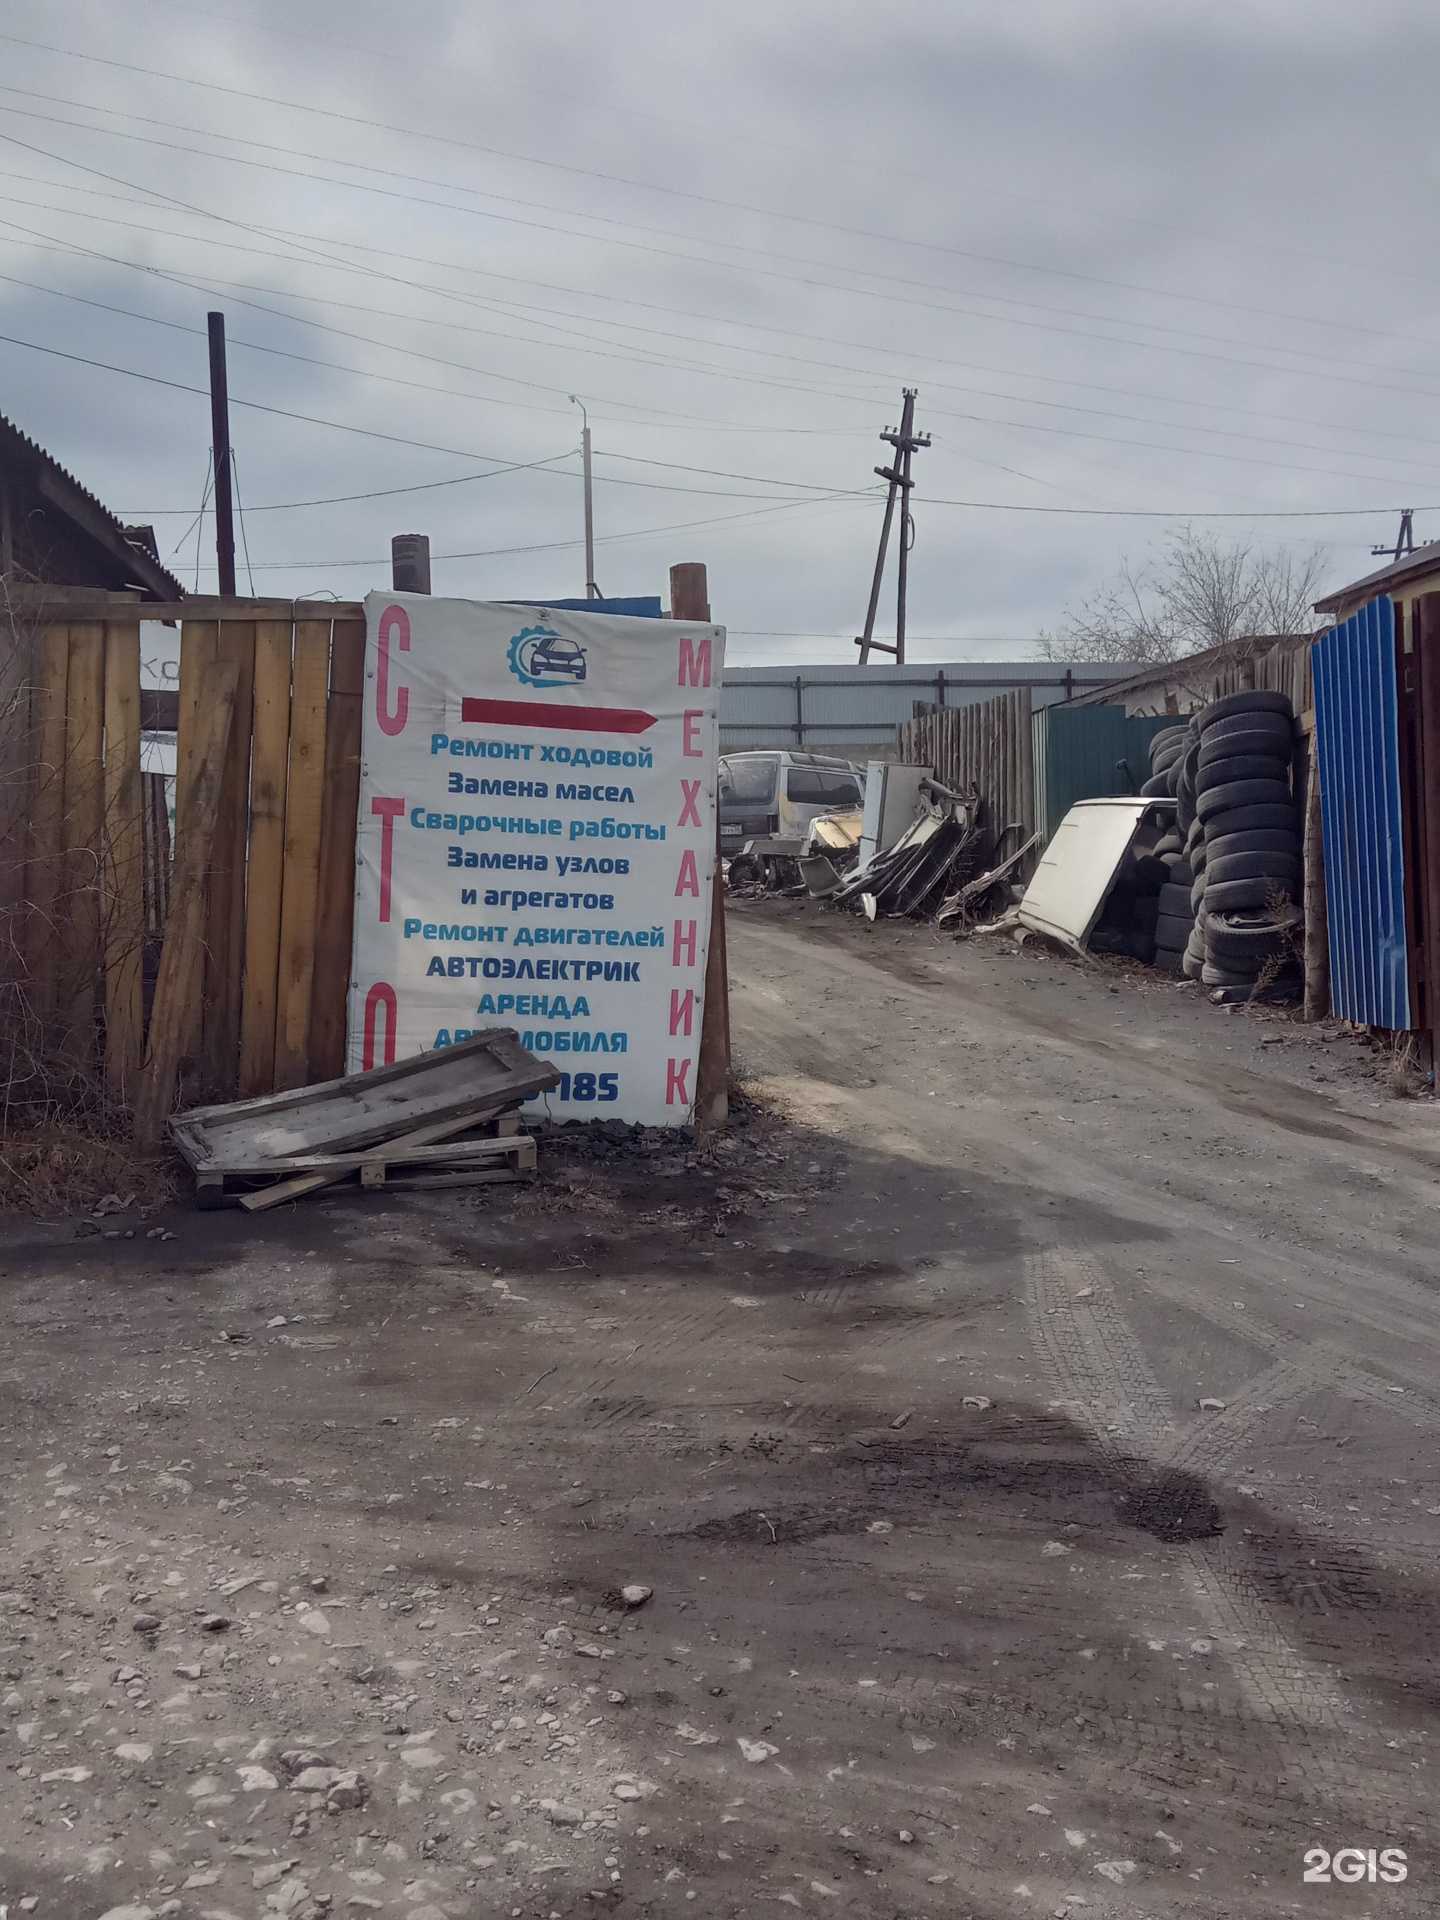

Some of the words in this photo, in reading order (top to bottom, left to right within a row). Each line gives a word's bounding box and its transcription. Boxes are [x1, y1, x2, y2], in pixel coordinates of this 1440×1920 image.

[430, 733, 534, 761] Ремонт
[540, 746, 653, 769] ходовой
[448, 772, 552, 799] Замена
[556, 783, 635, 804] масел
[410, 807, 562, 836] Сварочные
[569, 817, 667, 841] работы
[447, 846, 548, 872] Замена
[556, 855, 630, 877] узлов
[664, 638, 712, 1106] МЕХАНИК
[461, 889, 477, 905] и
[484, 889, 615, 912] агрегатов
[403, 918, 508, 943] Ремонт
[513, 926, 665, 948] двигателей
[426, 956, 641, 983] АВТОЭЛЕКТРИК
[476, 994, 590, 1020] АРЕНДА
[433, 1028, 628, 1053] АВМОБИЛЯ
